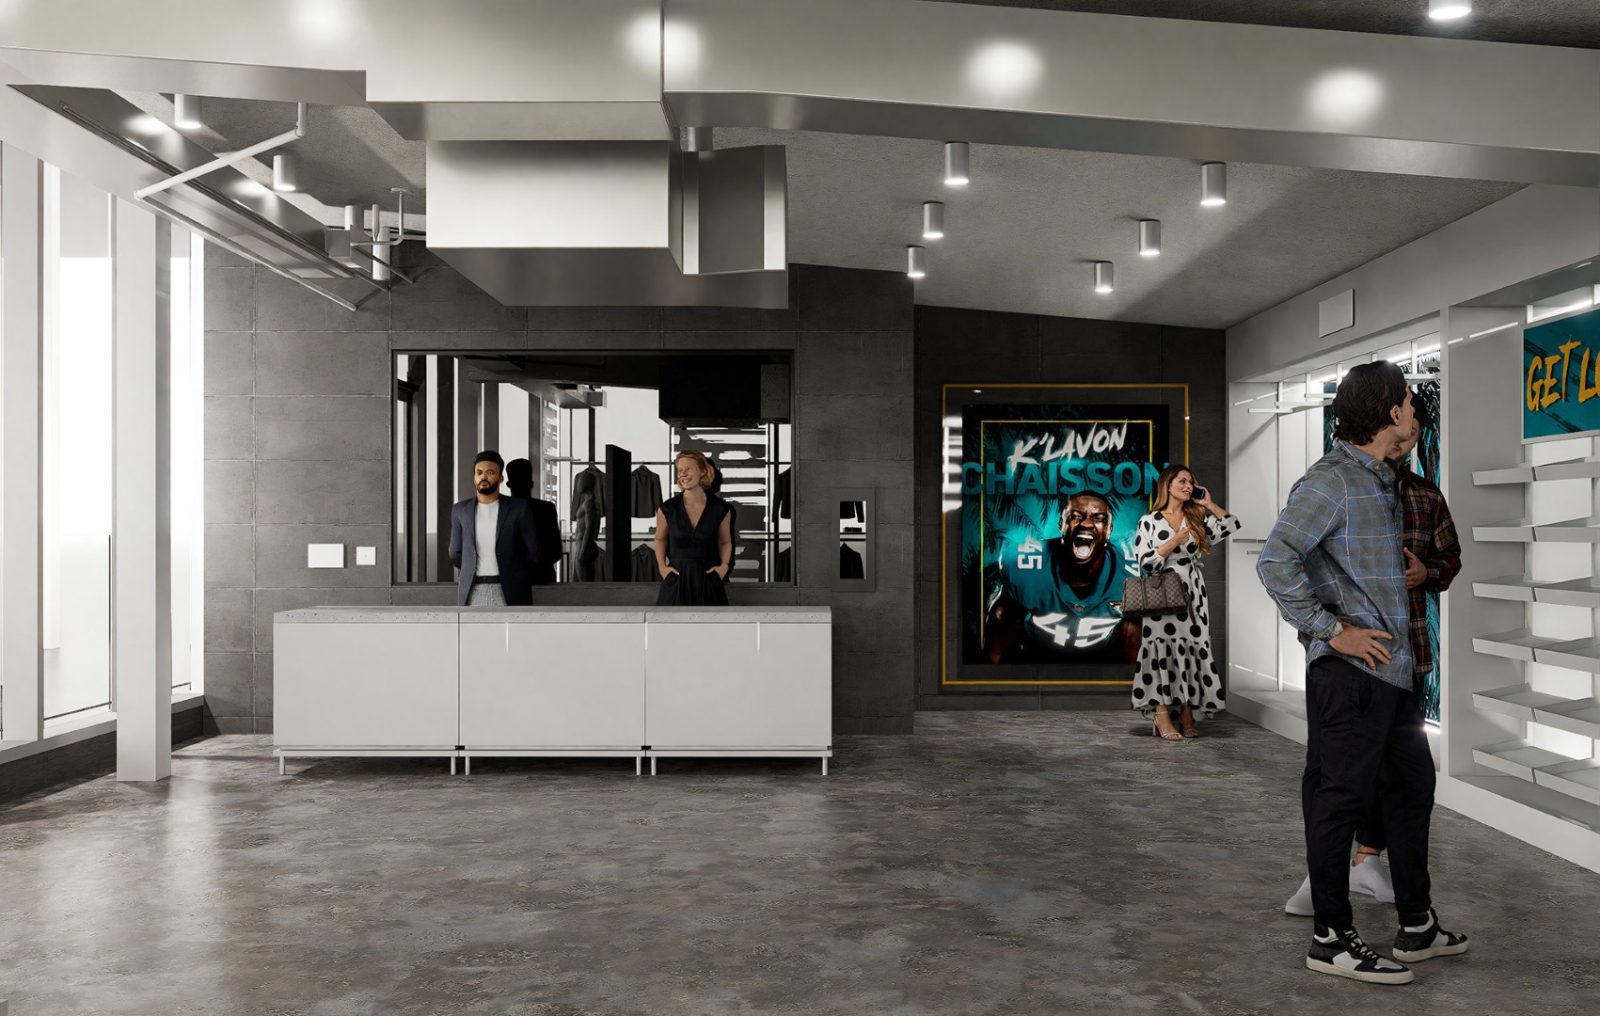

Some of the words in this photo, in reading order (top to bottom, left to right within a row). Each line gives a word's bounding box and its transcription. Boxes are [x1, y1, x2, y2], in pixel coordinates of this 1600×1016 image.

[1527, 339, 1582, 411] GET
[1008, 419, 1128, 476] K'LAVON
[1017, 535, 1043, 570] 45
[1032, 612, 1122, 648] 45
